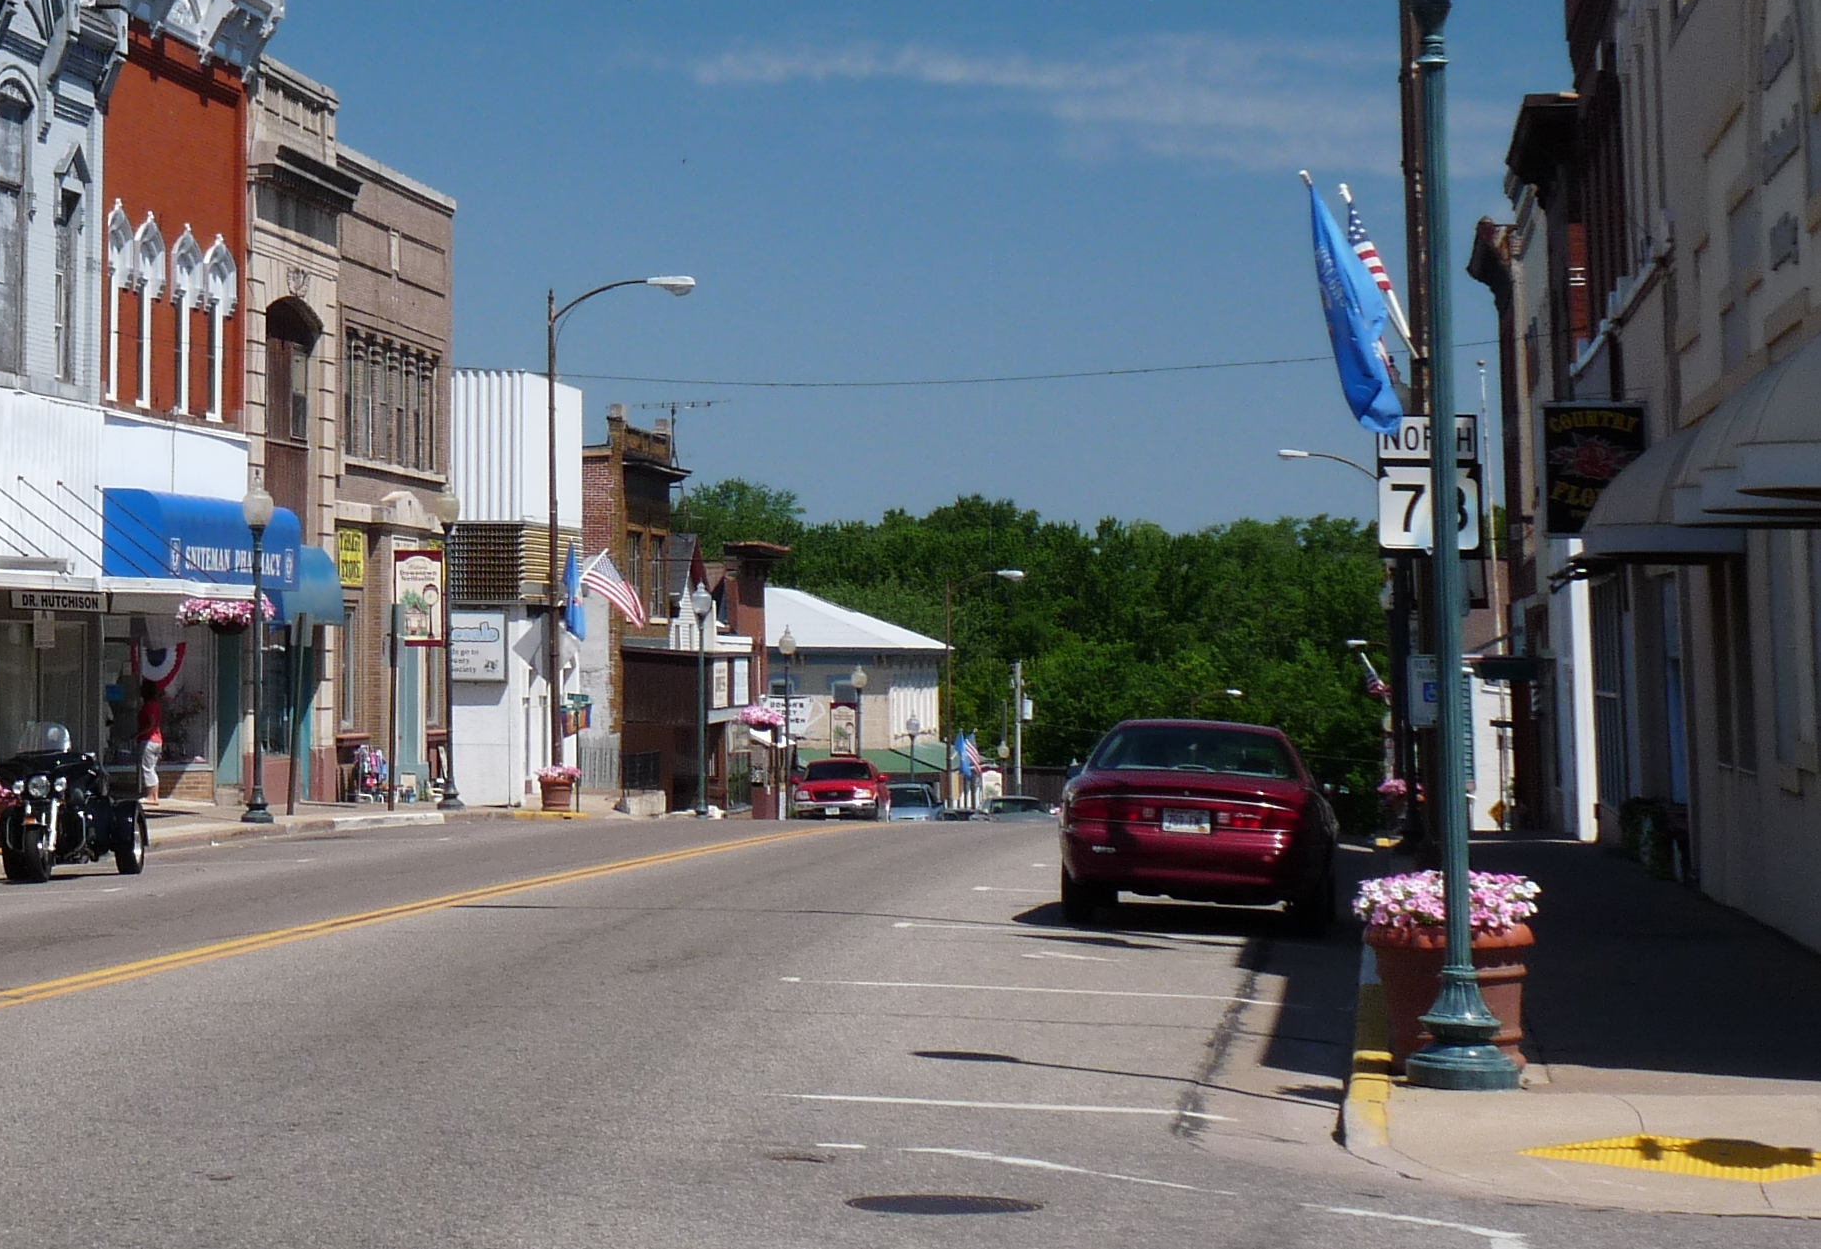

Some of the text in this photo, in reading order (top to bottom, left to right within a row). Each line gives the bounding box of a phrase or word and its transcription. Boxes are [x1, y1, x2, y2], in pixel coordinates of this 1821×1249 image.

[1383, 426, 1472, 452] NOH
[185, 546, 281, 576] SNITEMAN PHAACY
[22, 593, 99, 610] DR. HUTCHISON
